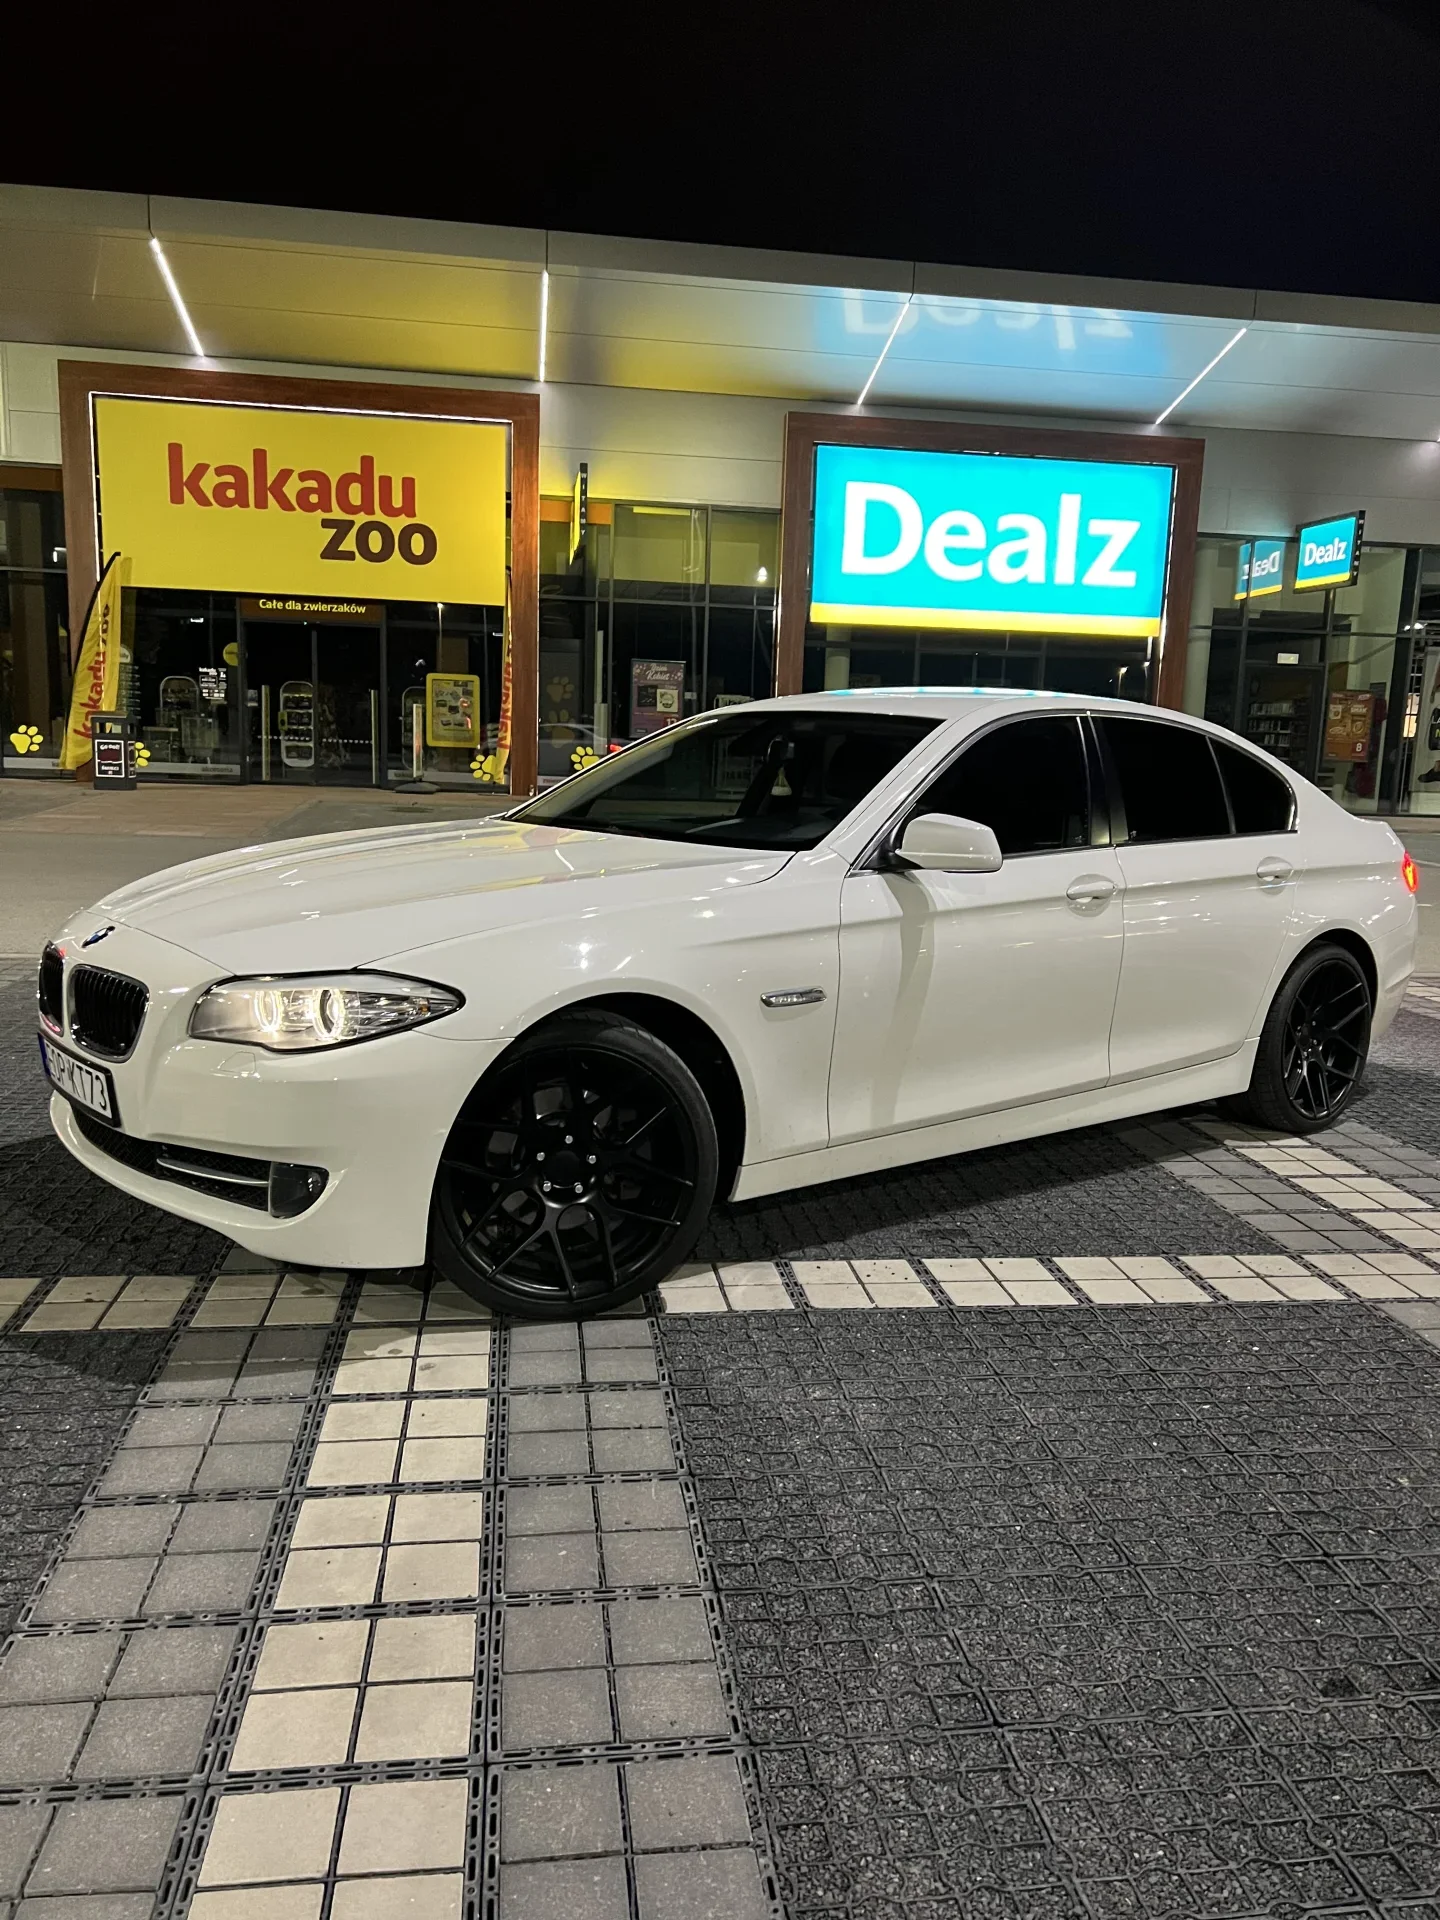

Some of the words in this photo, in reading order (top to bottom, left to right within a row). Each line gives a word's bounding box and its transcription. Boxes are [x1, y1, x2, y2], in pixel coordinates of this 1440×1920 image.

[167, 442, 417, 519] kakadu
[320, 517, 438, 566] zoo
[842, 482, 1141, 587] Dealz
[1303, 536, 1348, 567] Dealz
[259, 598, 284, 610] Całe
[285, 600, 302, 611] dla
[303, 602, 367, 614] zwierzaków
